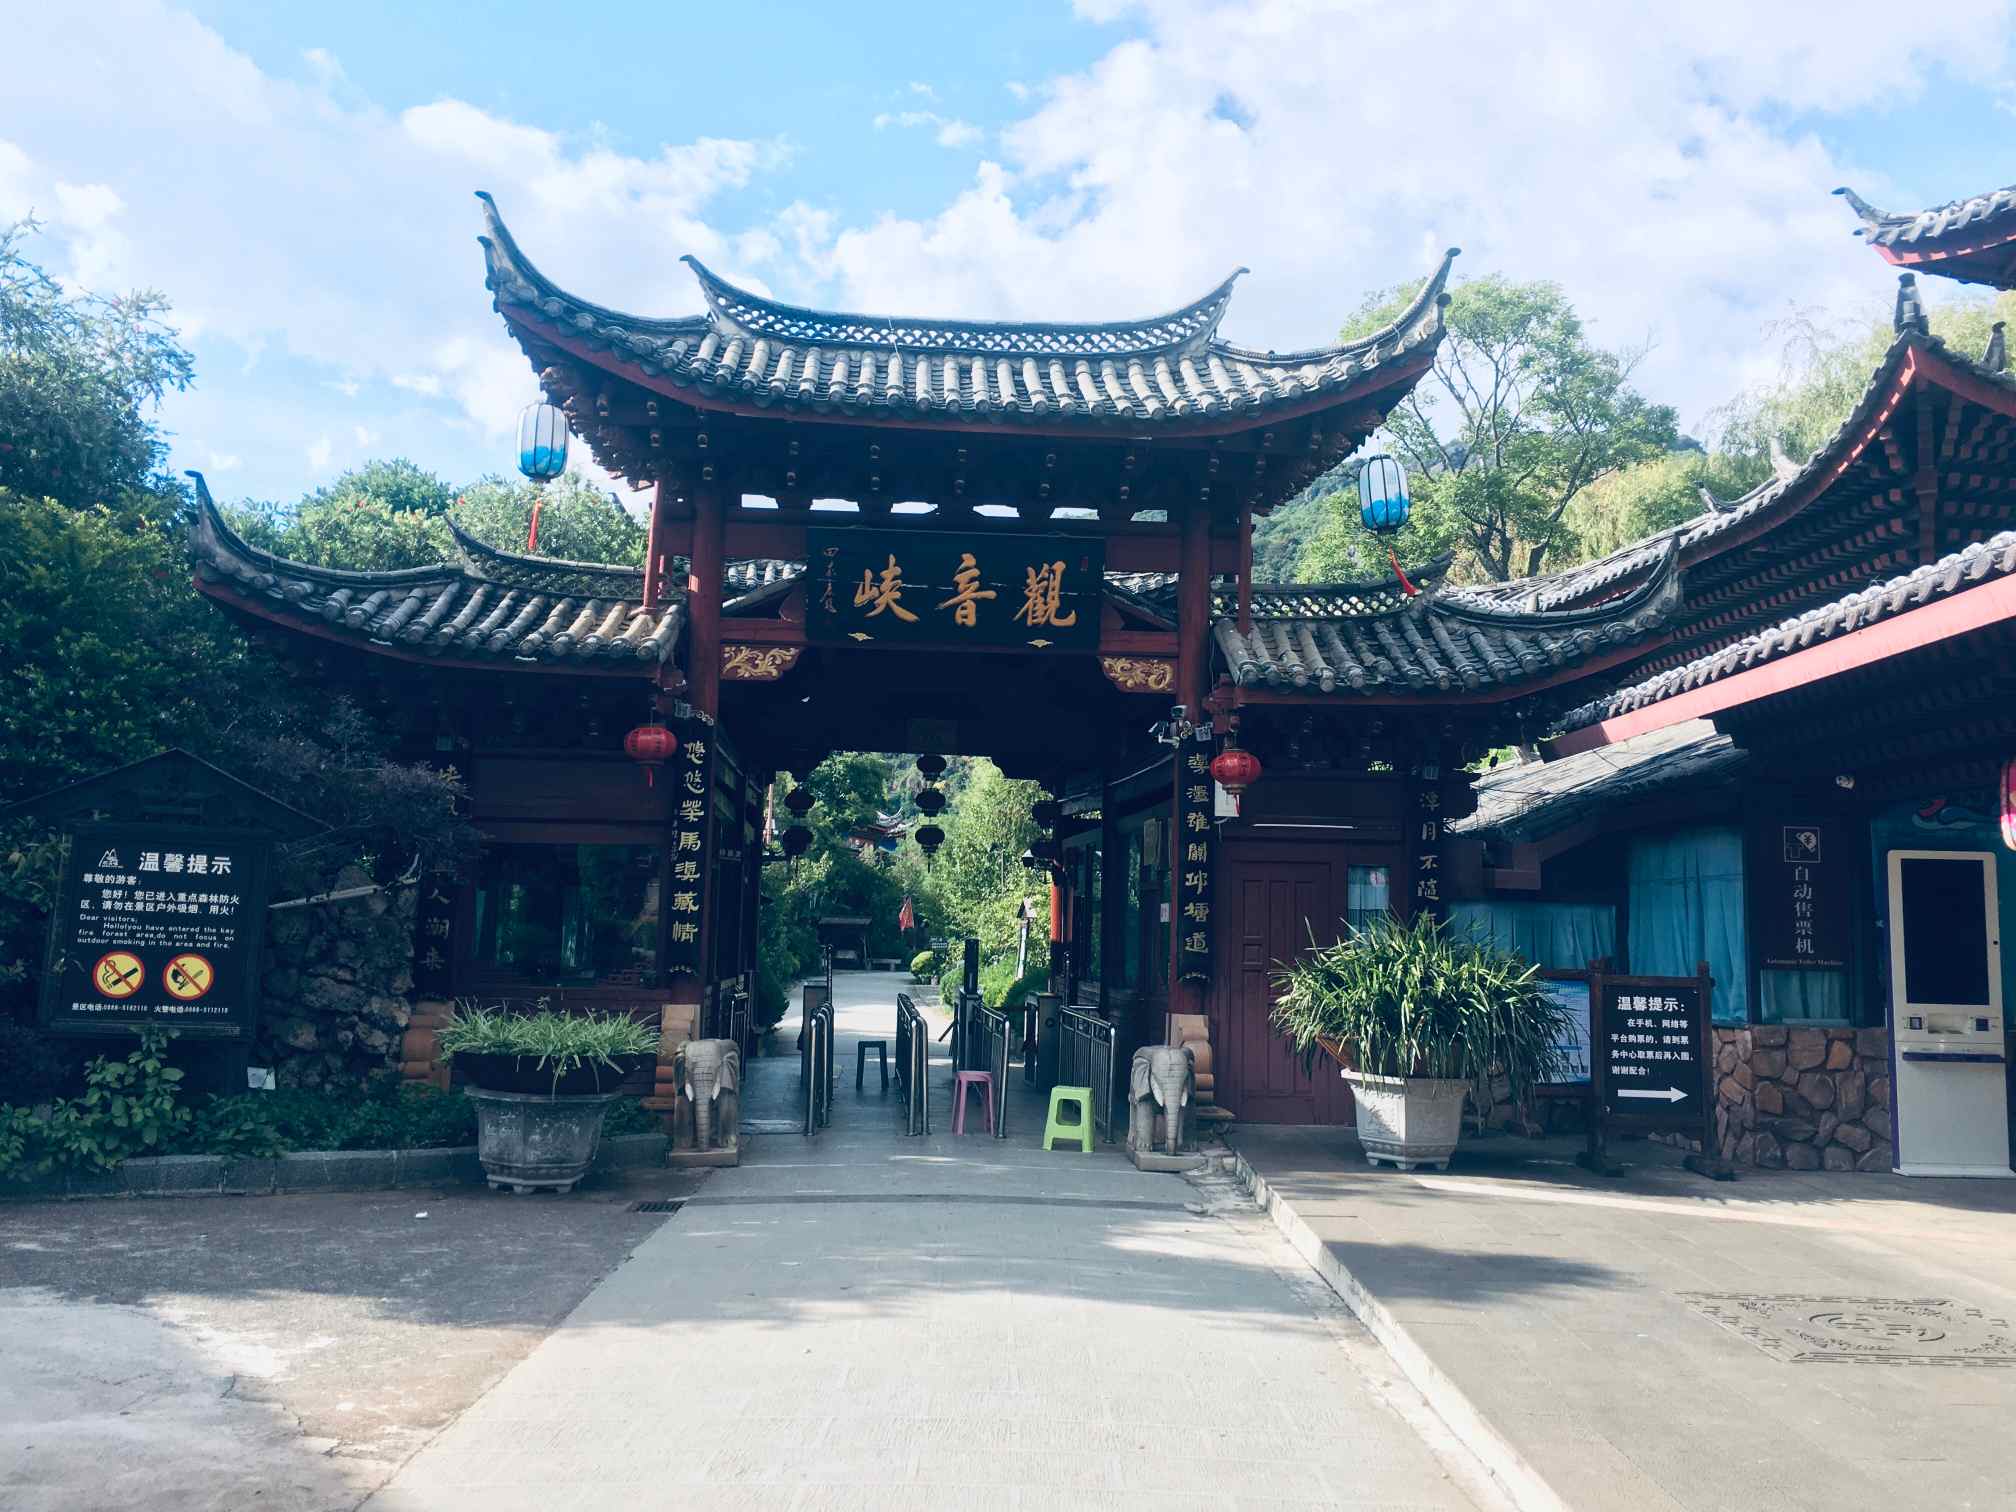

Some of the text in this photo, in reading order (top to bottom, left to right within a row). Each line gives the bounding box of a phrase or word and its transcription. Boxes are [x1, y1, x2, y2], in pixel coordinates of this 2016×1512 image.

[138, 851, 232, 875] 温馨提示
[1793, 866, 1815, 954] 自动售票机
[79, 913, 100, 922] Dear
[78, 928, 94, 936] fire
[195, 933, 217, 941] focus
[145, 923, 165, 931] have
[168, 925, 200, 933] entered
[220, 927, 235, 935] key
[77, 936, 109, 944] outdoor
[112, 938, 145, 947] smoking
[159, 939, 173, 947] the
[196, 940, 210, 948] and
